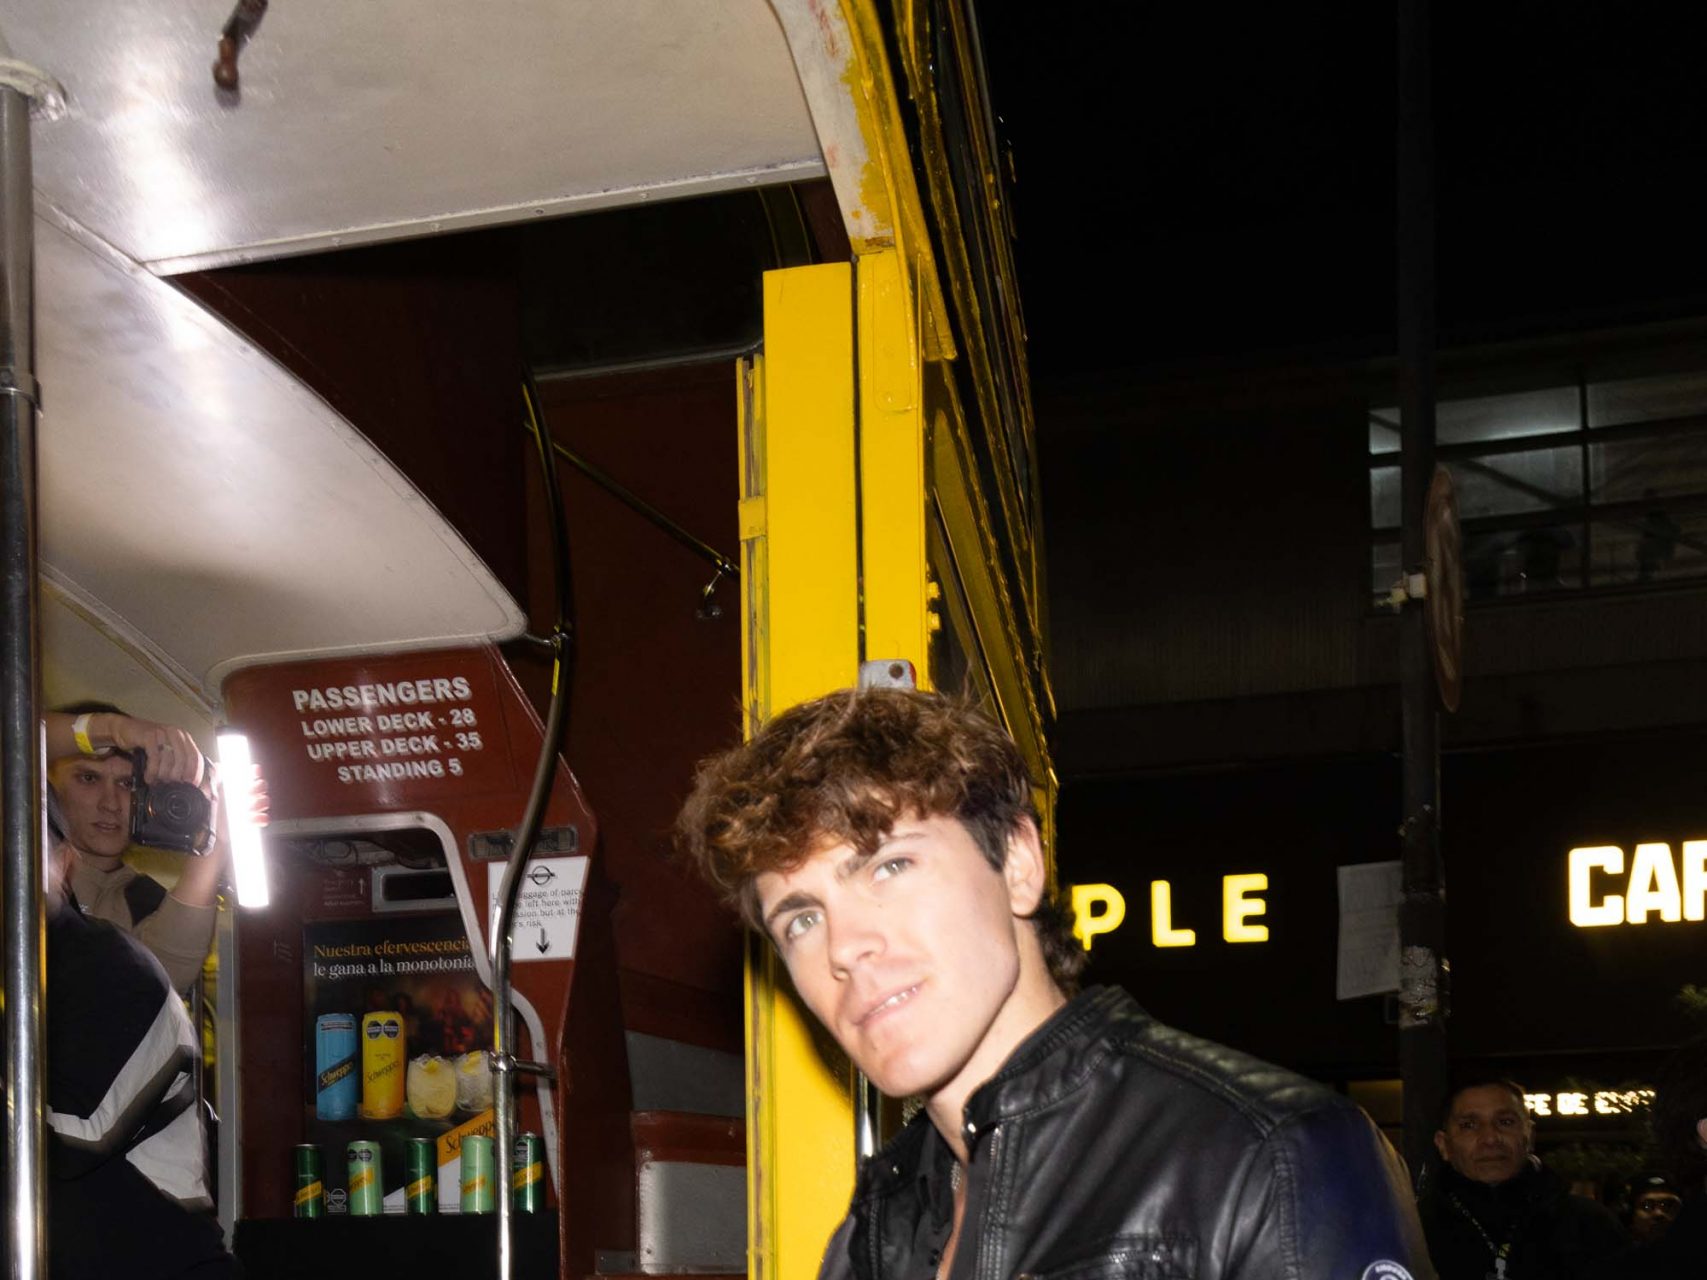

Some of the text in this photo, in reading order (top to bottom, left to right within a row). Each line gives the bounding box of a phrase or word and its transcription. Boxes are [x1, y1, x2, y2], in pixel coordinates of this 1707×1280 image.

[292, 677, 472, 711] PASSENGERS
[301, 716, 374, 738] LOWER
[377, 711, 435, 732] DECK
[449, 708, 477, 727] 28
[307, 740, 378, 761] UPPER
[381, 735, 441, 756] DECK
[455, 732, 484, 752] 35
[337, 758, 464, 784] STANDING 5
[313, 944, 371, 958] Nuestra
[313, 954, 476, 980] le gana a la monotonía
